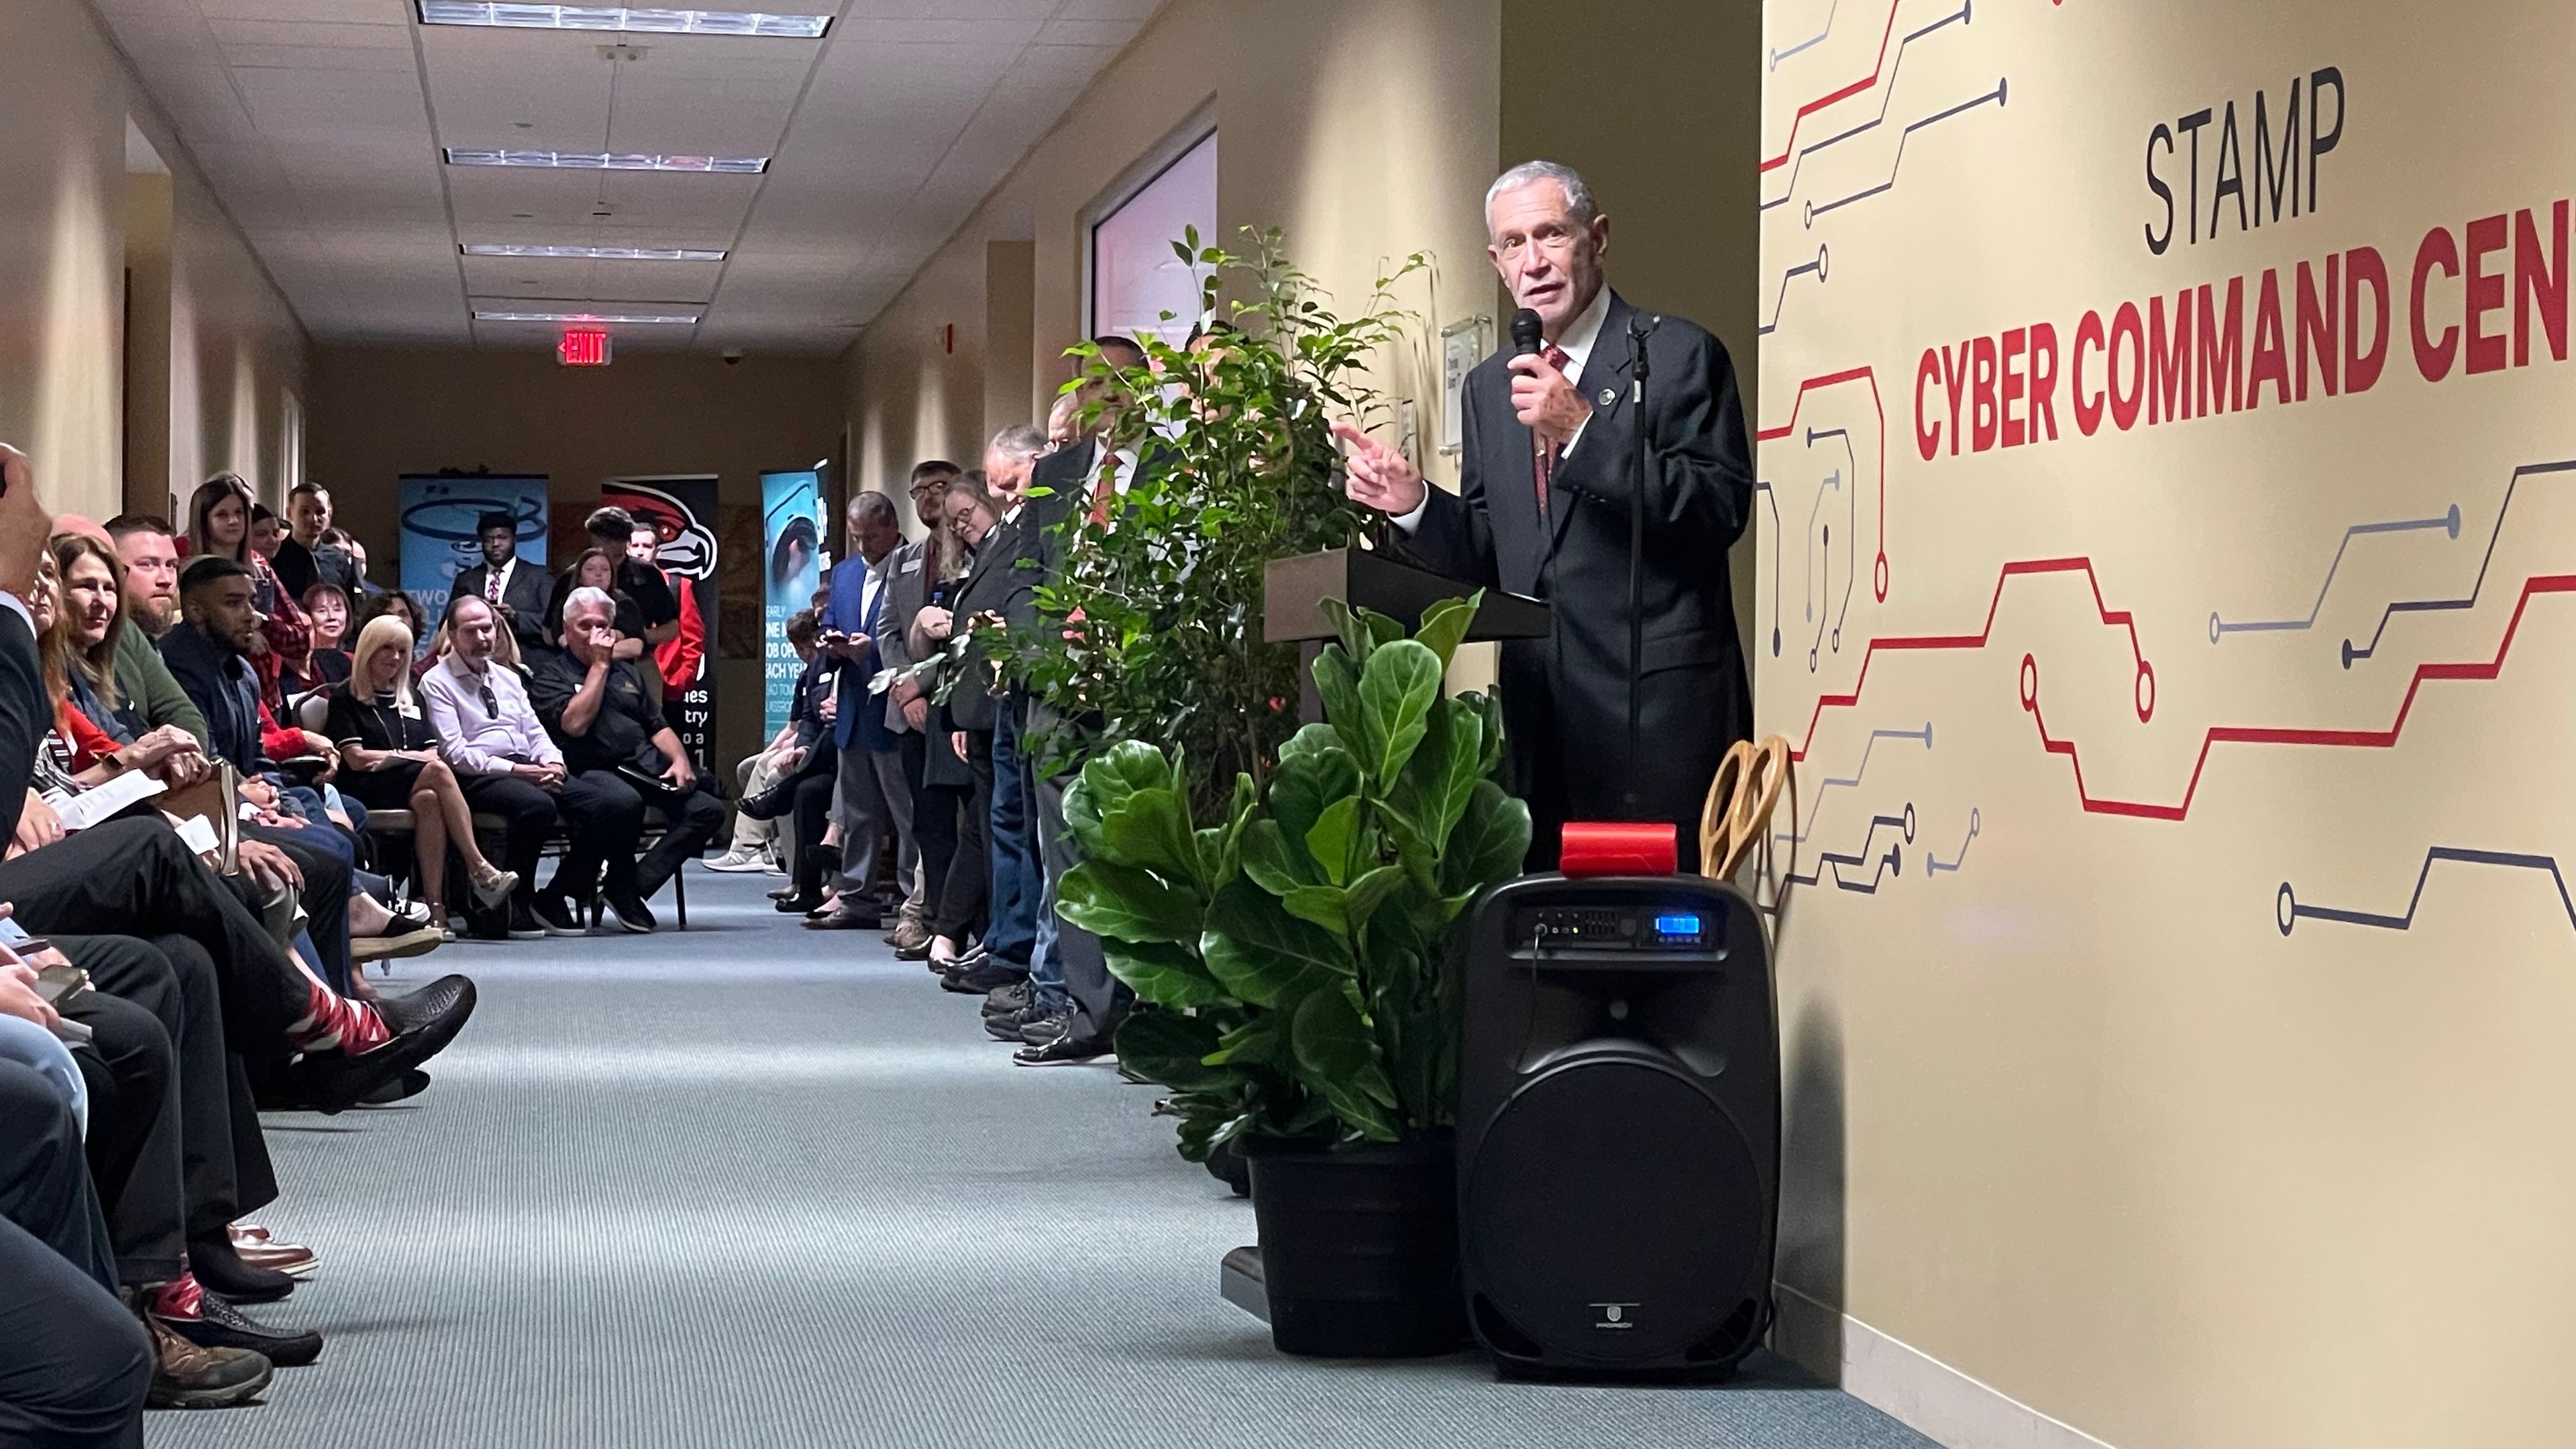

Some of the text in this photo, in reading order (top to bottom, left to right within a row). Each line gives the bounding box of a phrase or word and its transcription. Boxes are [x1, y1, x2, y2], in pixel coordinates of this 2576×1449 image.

[2145, 66, 2346, 256] STAMP
[566, 333, 606, 363] EXIT
[1915, 198, 2576, 462] CYBER COMMAND CEN
